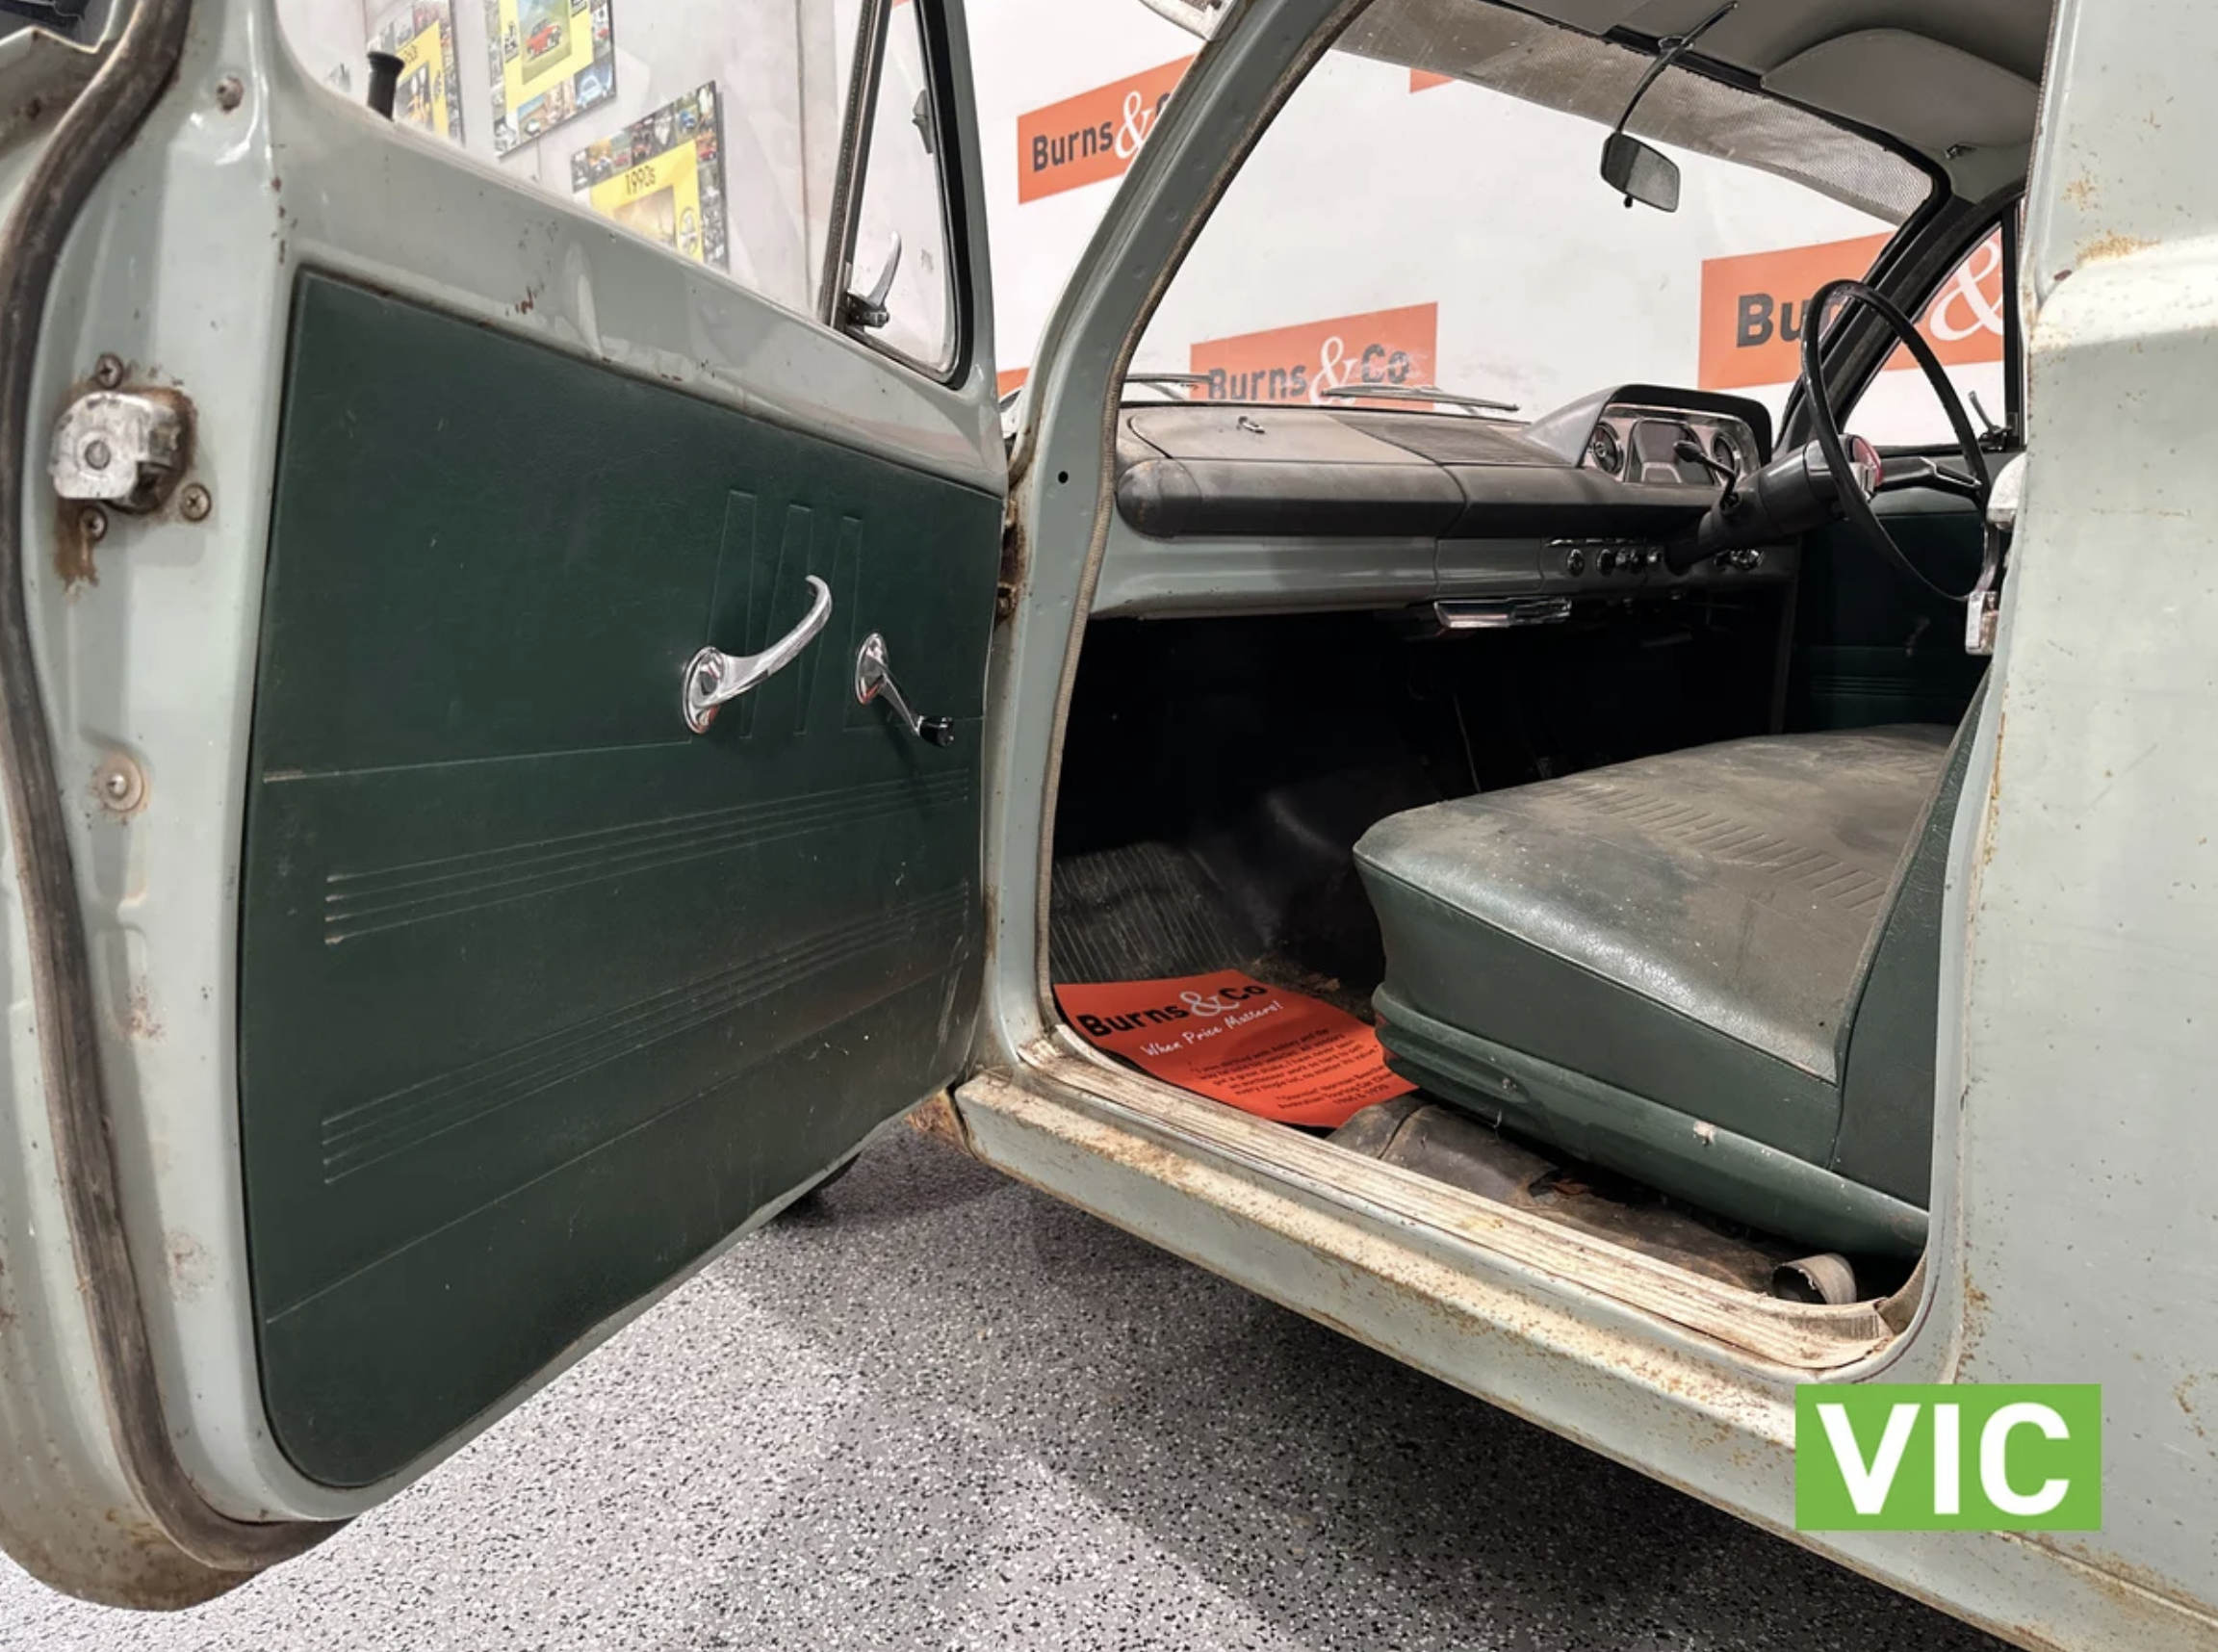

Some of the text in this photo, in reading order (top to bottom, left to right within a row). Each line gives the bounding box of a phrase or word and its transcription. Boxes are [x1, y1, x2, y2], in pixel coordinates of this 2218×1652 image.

[1032, 90, 1171, 172] Burns&
[1076, 985, 1268, 1037] Burns&Co
[1141, 1000, 1284, 1056] When Price Matters!
